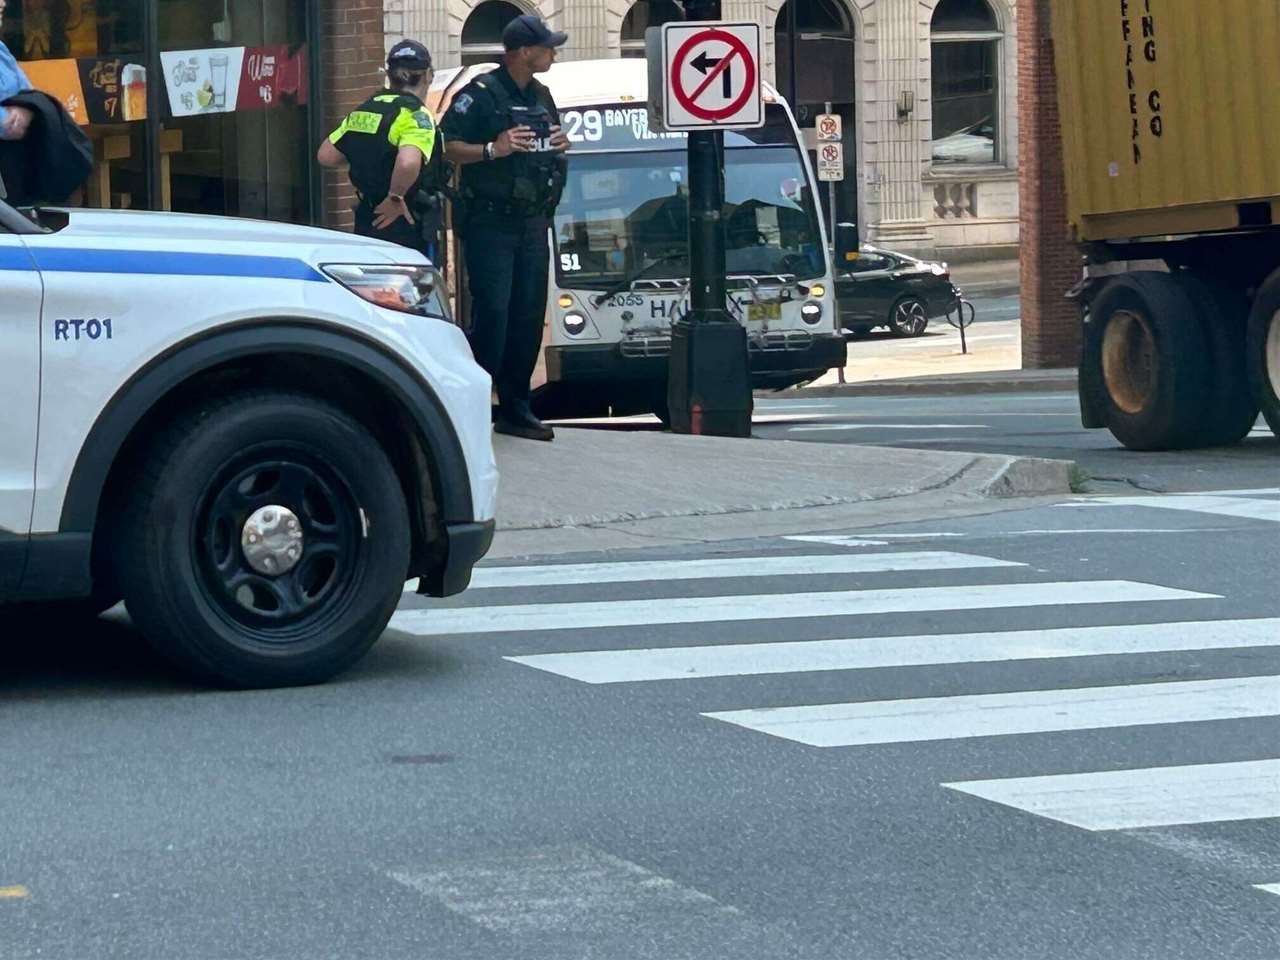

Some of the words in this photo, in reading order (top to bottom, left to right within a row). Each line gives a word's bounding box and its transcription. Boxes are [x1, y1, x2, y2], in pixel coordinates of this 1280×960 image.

[564, 109, 603, 142] 29
[604, 108, 648, 127] BAYER
[1148, 89, 1163, 138] CO
[560, 253, 582, 271] 51
